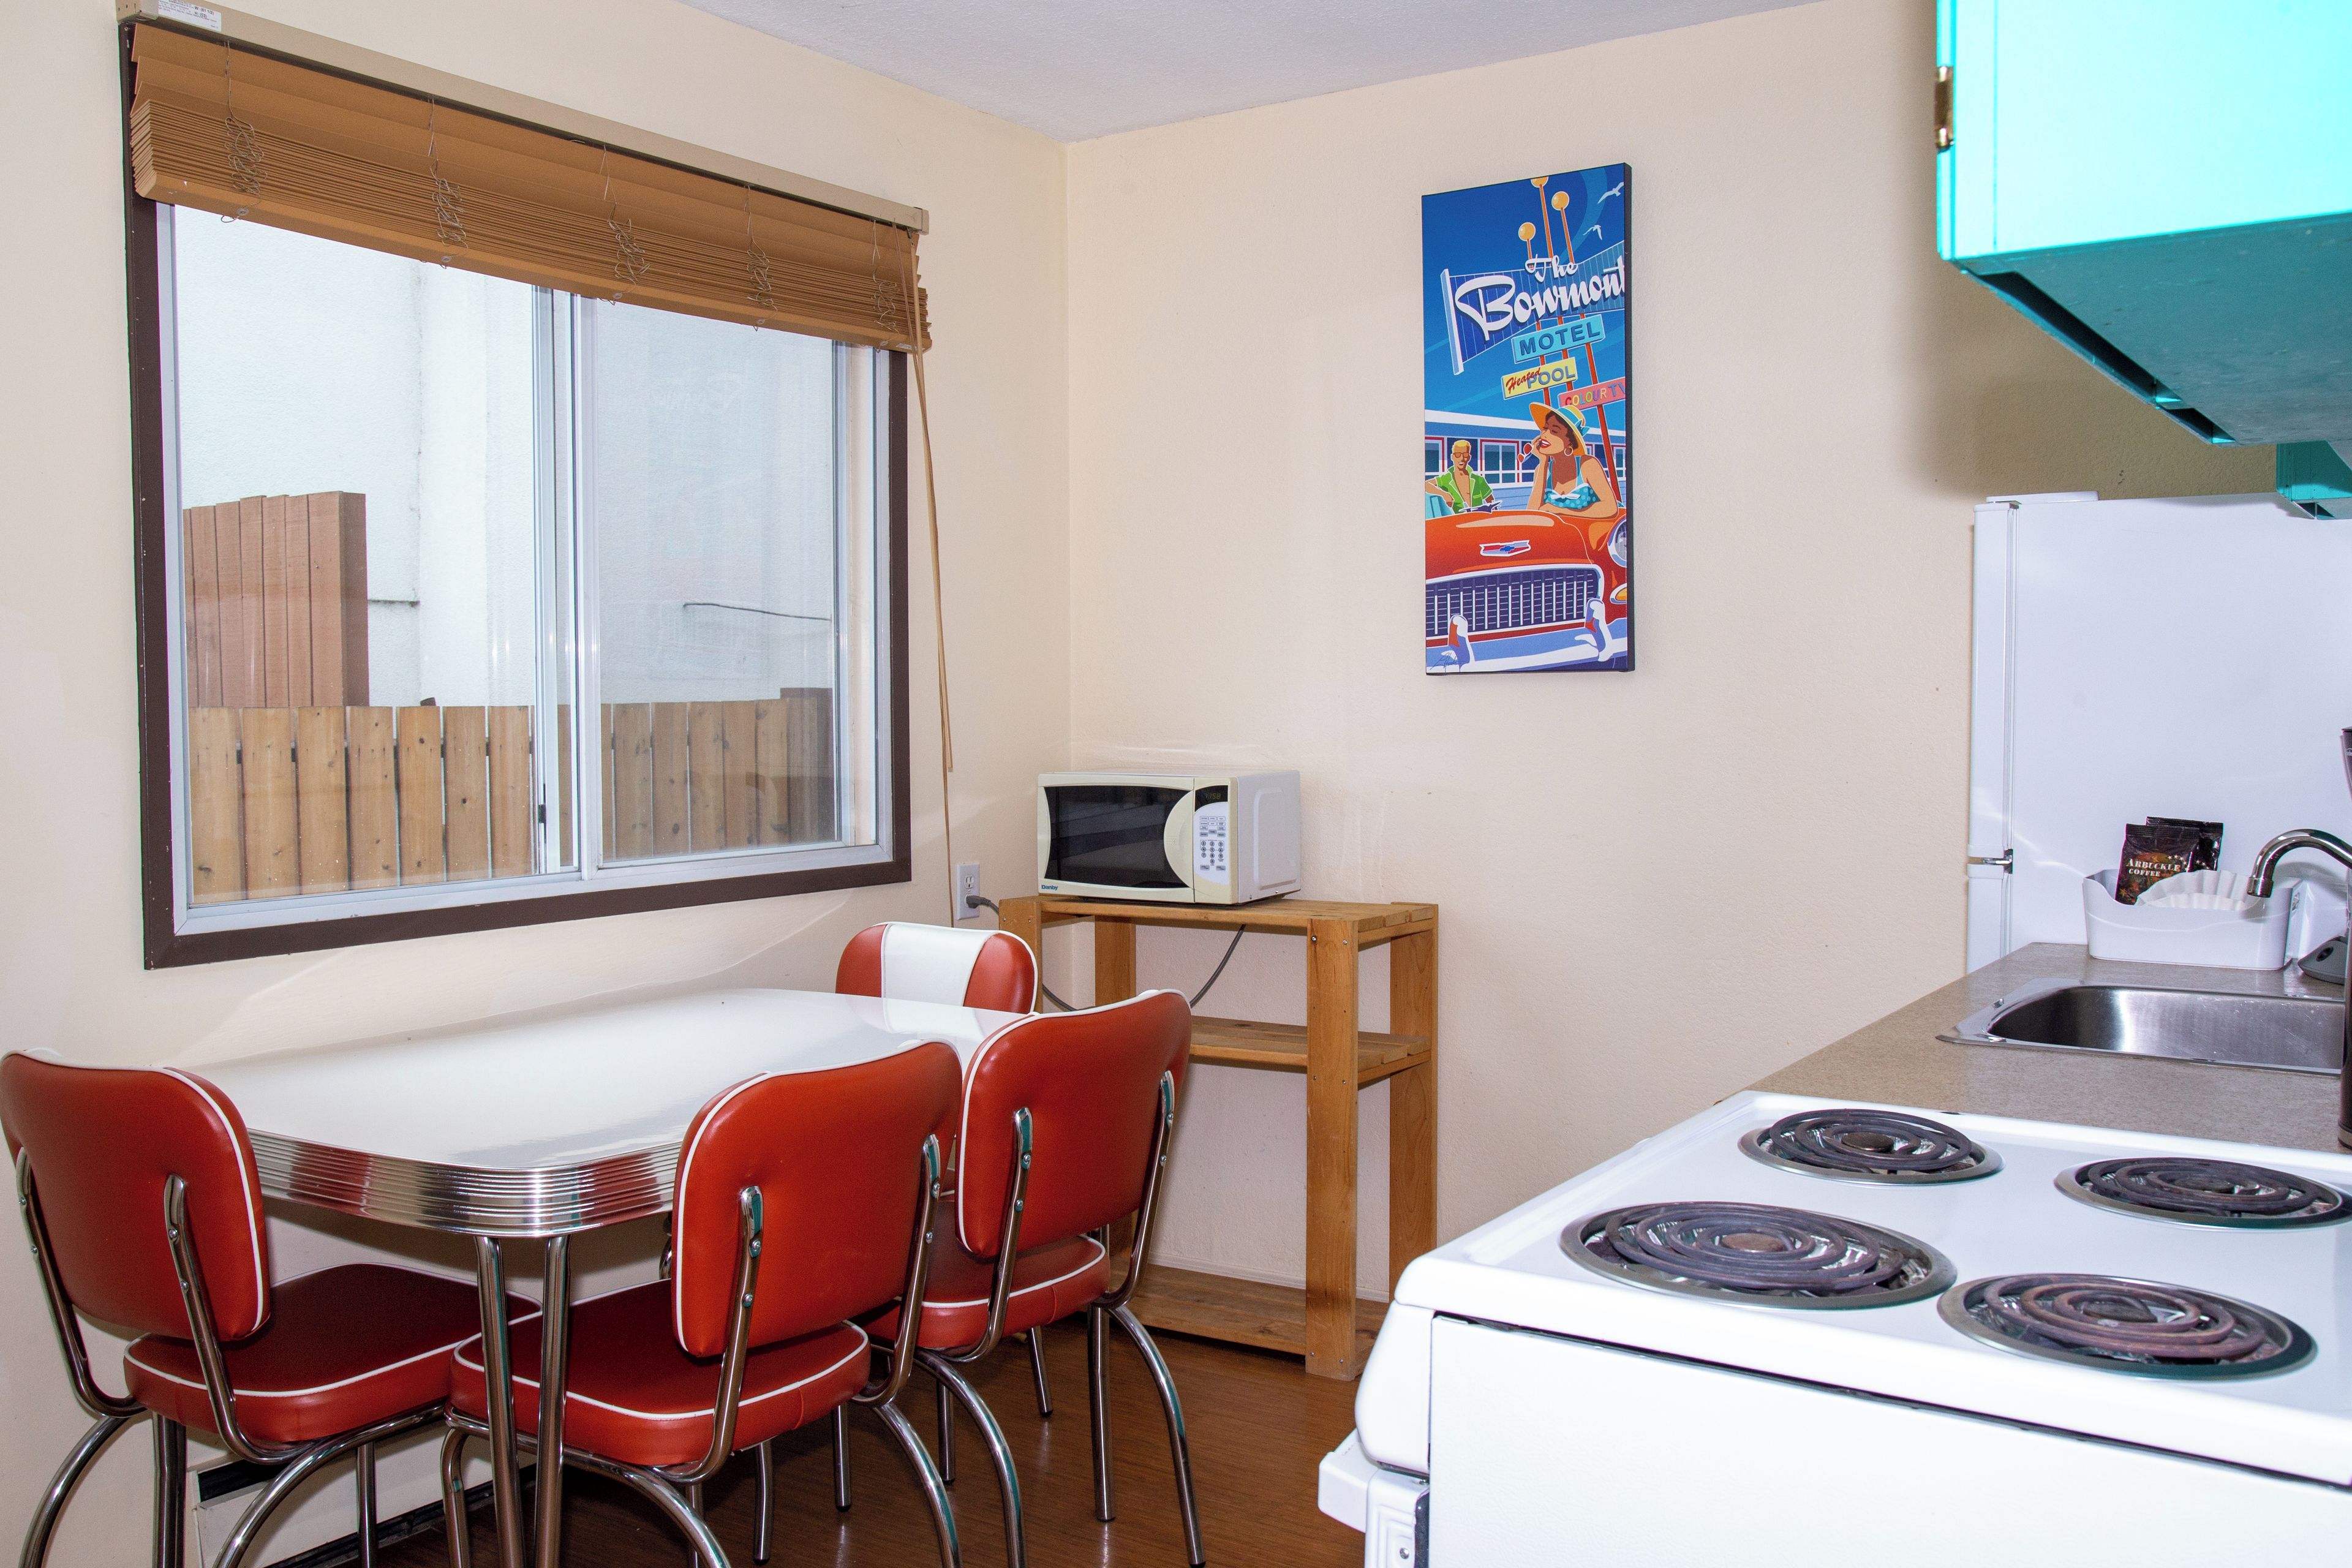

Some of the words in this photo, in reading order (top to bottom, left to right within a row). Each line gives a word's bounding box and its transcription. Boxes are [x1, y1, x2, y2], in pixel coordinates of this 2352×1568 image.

[1525, 254, 1578, 284] The
[1454, 255, 1625, 341] Bowmont
[1518, 320, 1602, 355] MOTEL
[1506, 367, 1541, 394] Heated
[1527, 366, 1576, 389] POOL
[1565, 388, 1607, 406] COLOUR
[2125, 858, 2181, 872] ARBUCKLE
